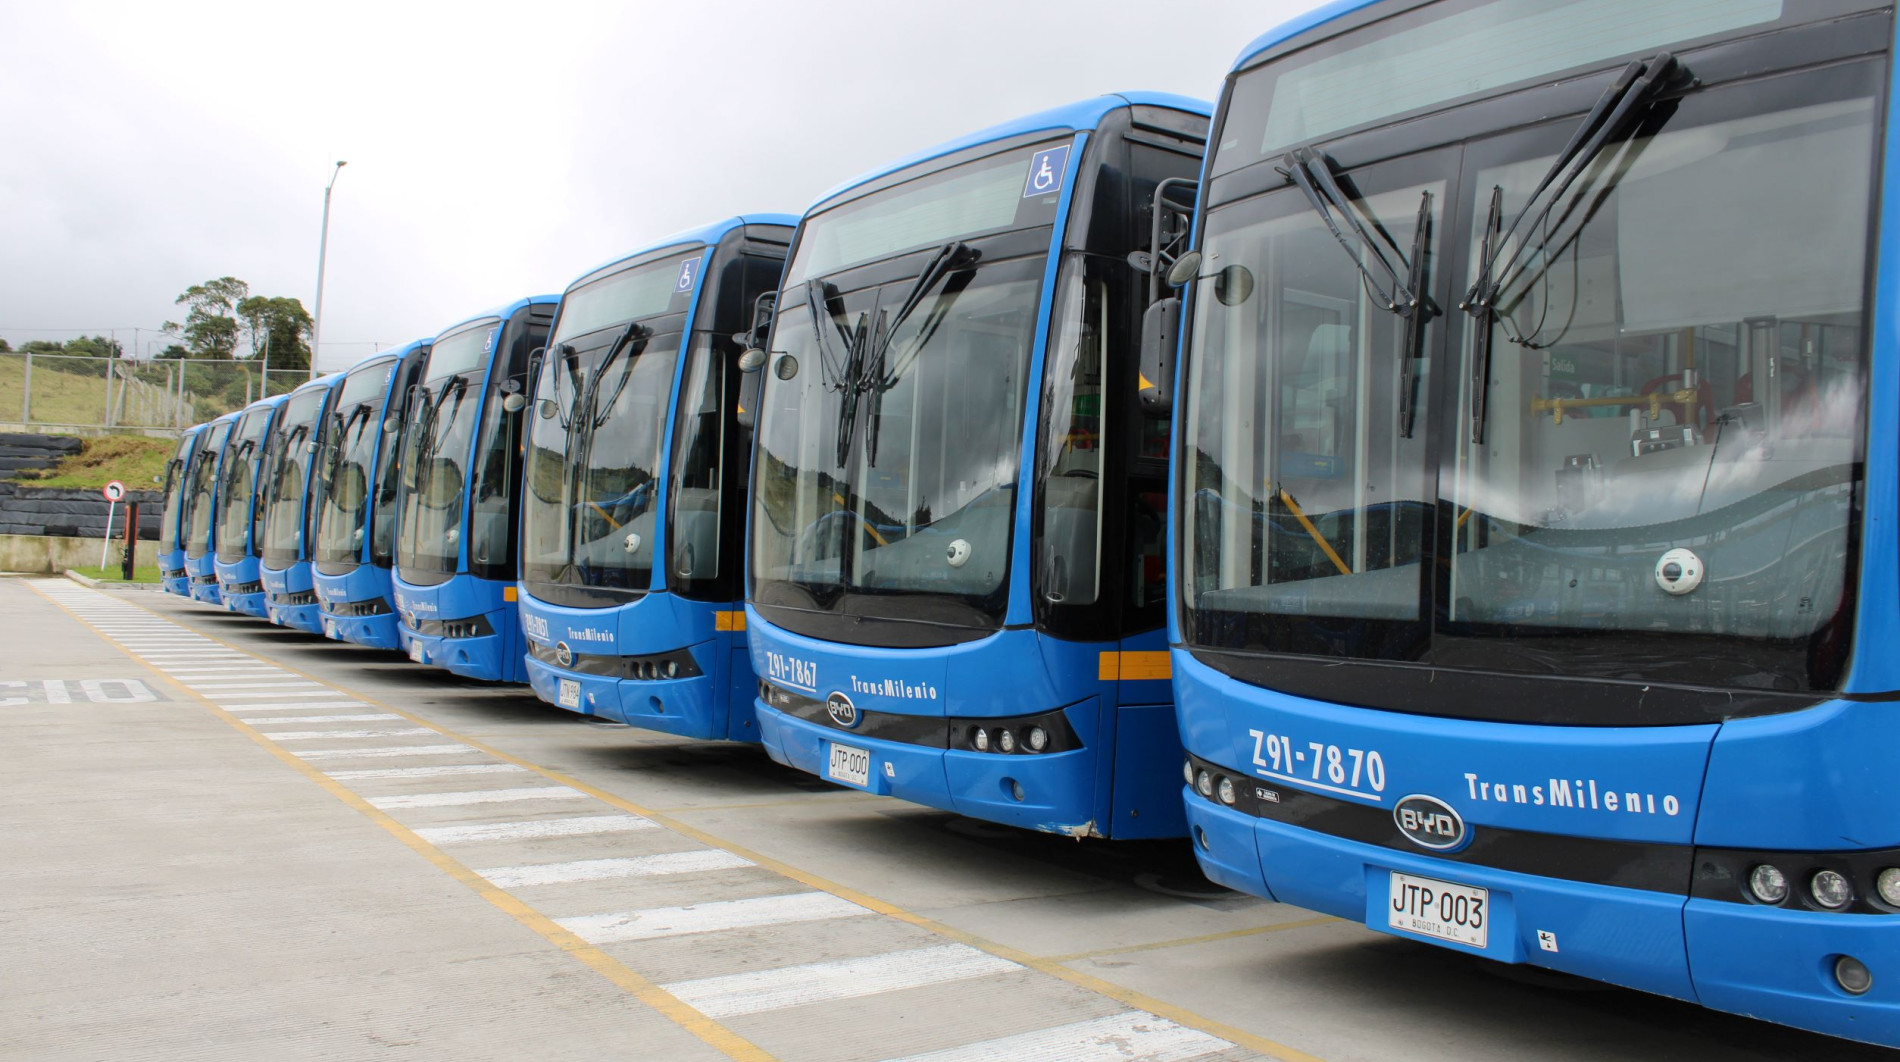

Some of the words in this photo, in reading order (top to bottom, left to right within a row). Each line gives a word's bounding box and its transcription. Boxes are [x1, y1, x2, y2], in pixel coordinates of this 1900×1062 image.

[1552, 358, 1576, 373] Salida
[568, 627, 614, 642] TransMilenio
[766, 651, 817, 687] Z91-7867
[851, 675, 937, 700] TransMilenio
[829, 700, 853, 718] BYD
[831, 749, 848, 769] JTP
[849, 753, 868, 775] 000
[1249, 728, 1386, 792] Z91-7870
[1464, 772, 1680, 816] TransMilenio
[1400, 808, 1456, 837] BYD
[1393, 883, 1434, 917] JTP
[1440, 892, 1483, 929] 003
[1412, 919, 1441, 933] BOGOTA
